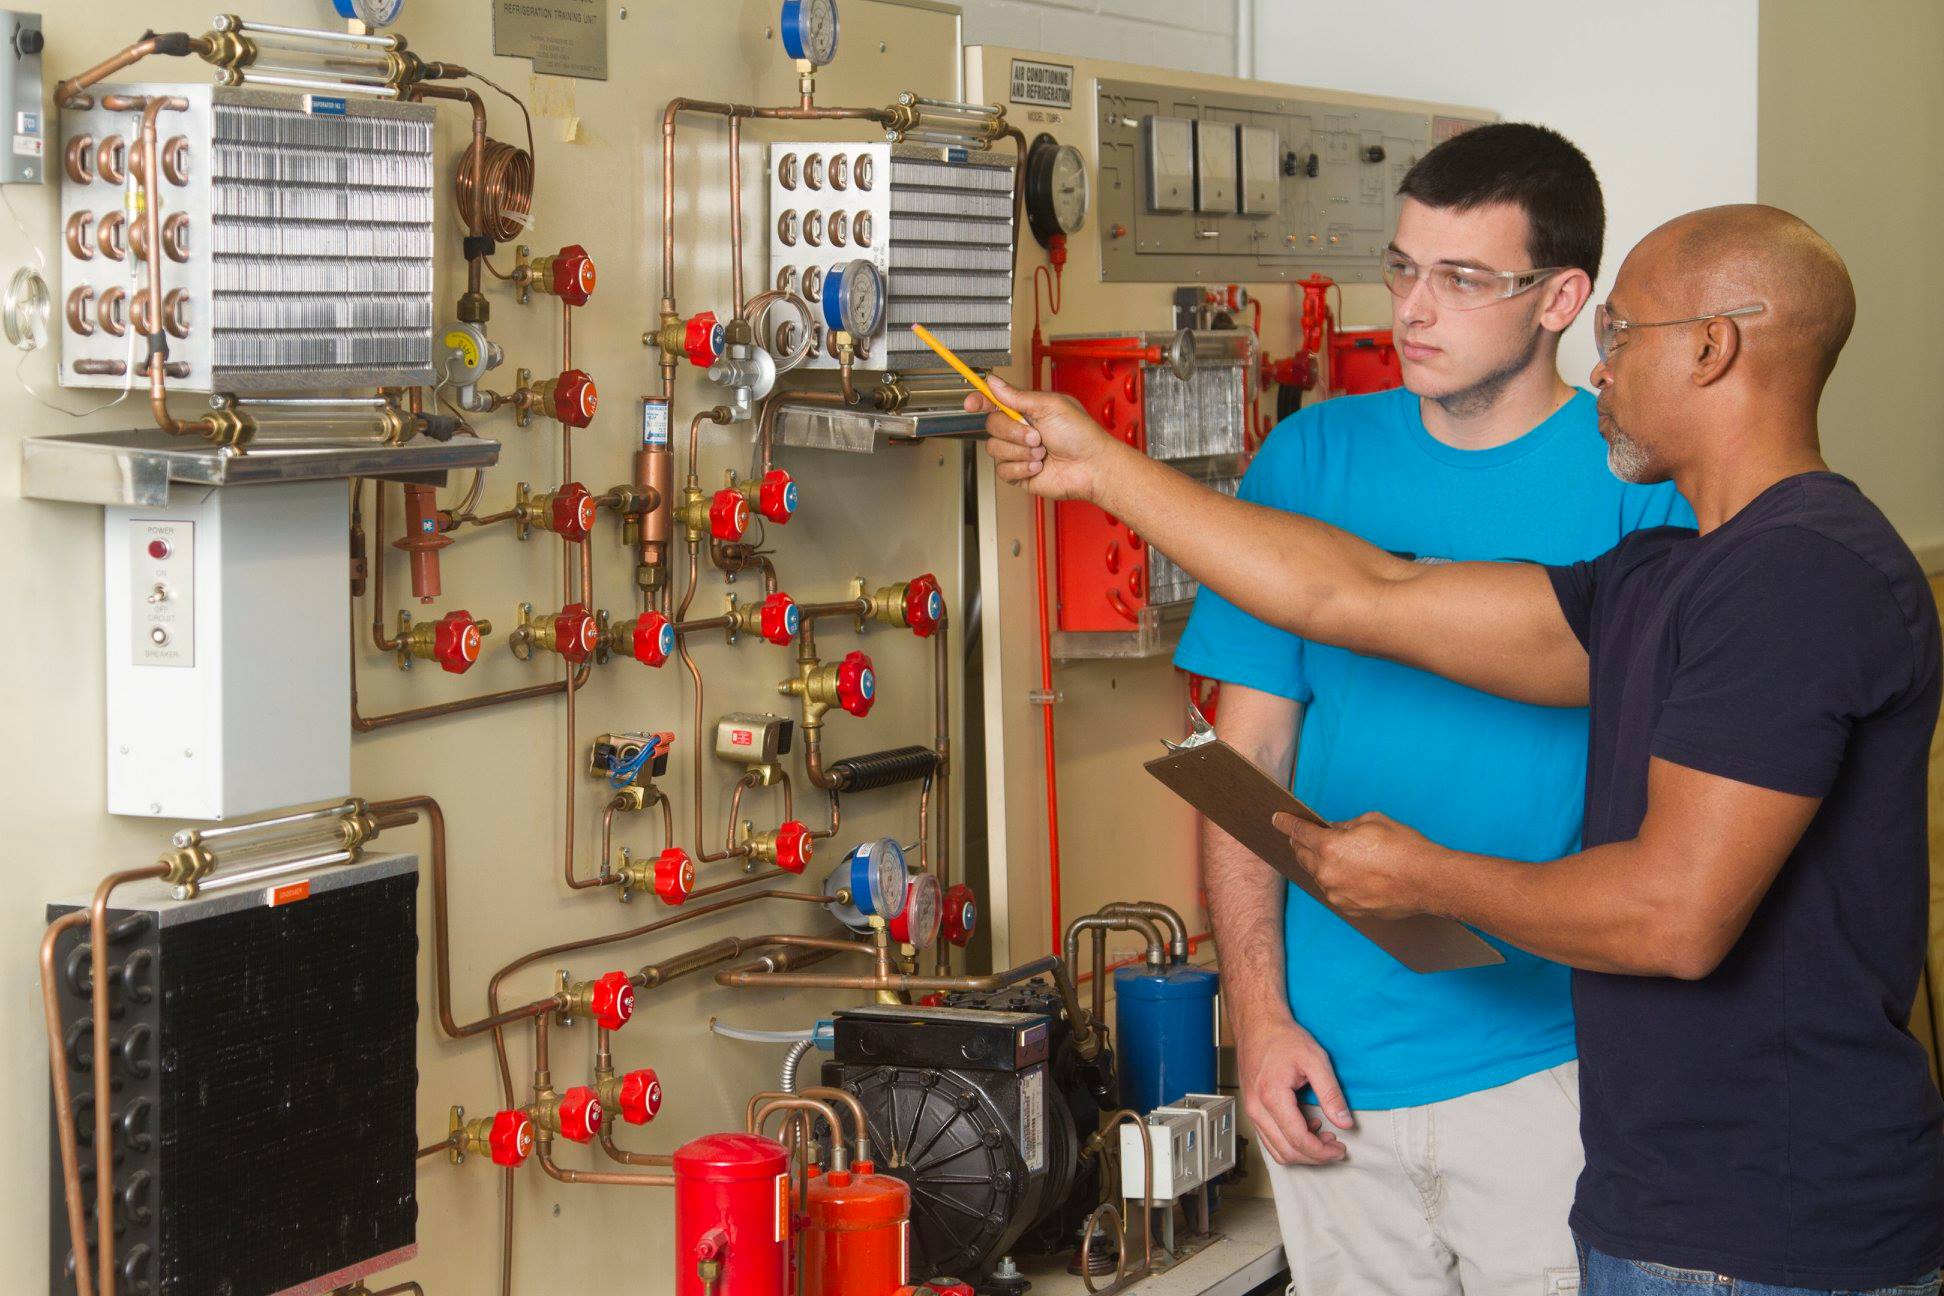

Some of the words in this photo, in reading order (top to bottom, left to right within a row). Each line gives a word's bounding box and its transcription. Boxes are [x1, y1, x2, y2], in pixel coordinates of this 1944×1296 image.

[503, 3, 552, 19] REFRIGERATION
[554, 9, 582, 24] TRAINING
[583, 14, 598, 25] UNIT
[1014, 65, 1025, 81] AIR
[1026, 66, 1069, 87] CONDITIONING
[1012, 81, 1025, 98] AND
[1026, 82, 1071, 103] REFRIGERATION
[147, 526, 175, 535] POWER
[155, 569, 167, 577] ON
[147, 614, 176, 623] CIRCUIT
